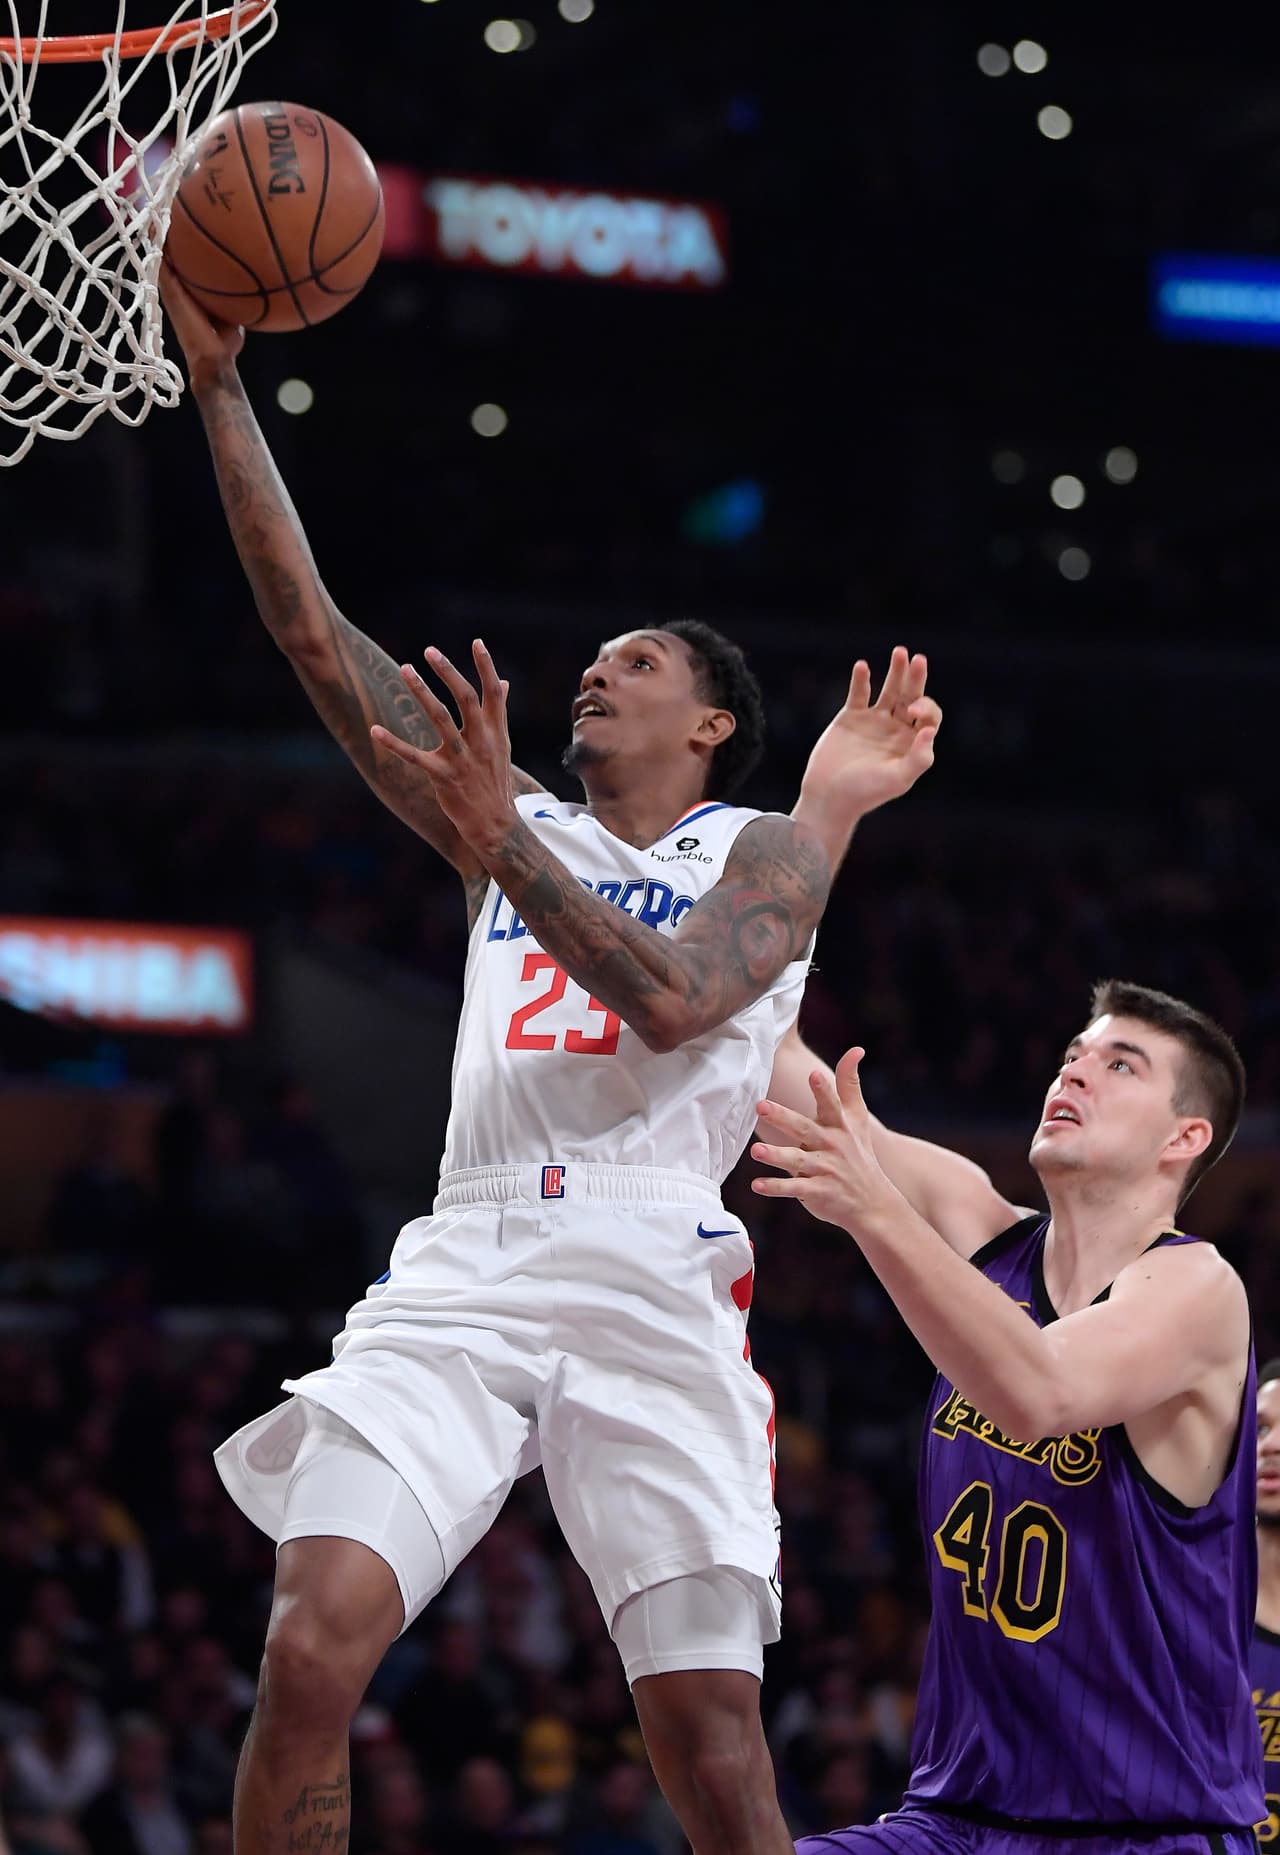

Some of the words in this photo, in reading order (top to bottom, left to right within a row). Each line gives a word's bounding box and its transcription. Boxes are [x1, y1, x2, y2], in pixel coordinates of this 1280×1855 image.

[424, 178, 724, 286] TOYOTA
[650, 849, 713, 864] humble
[933, 1479, 1067, 1643] 40
